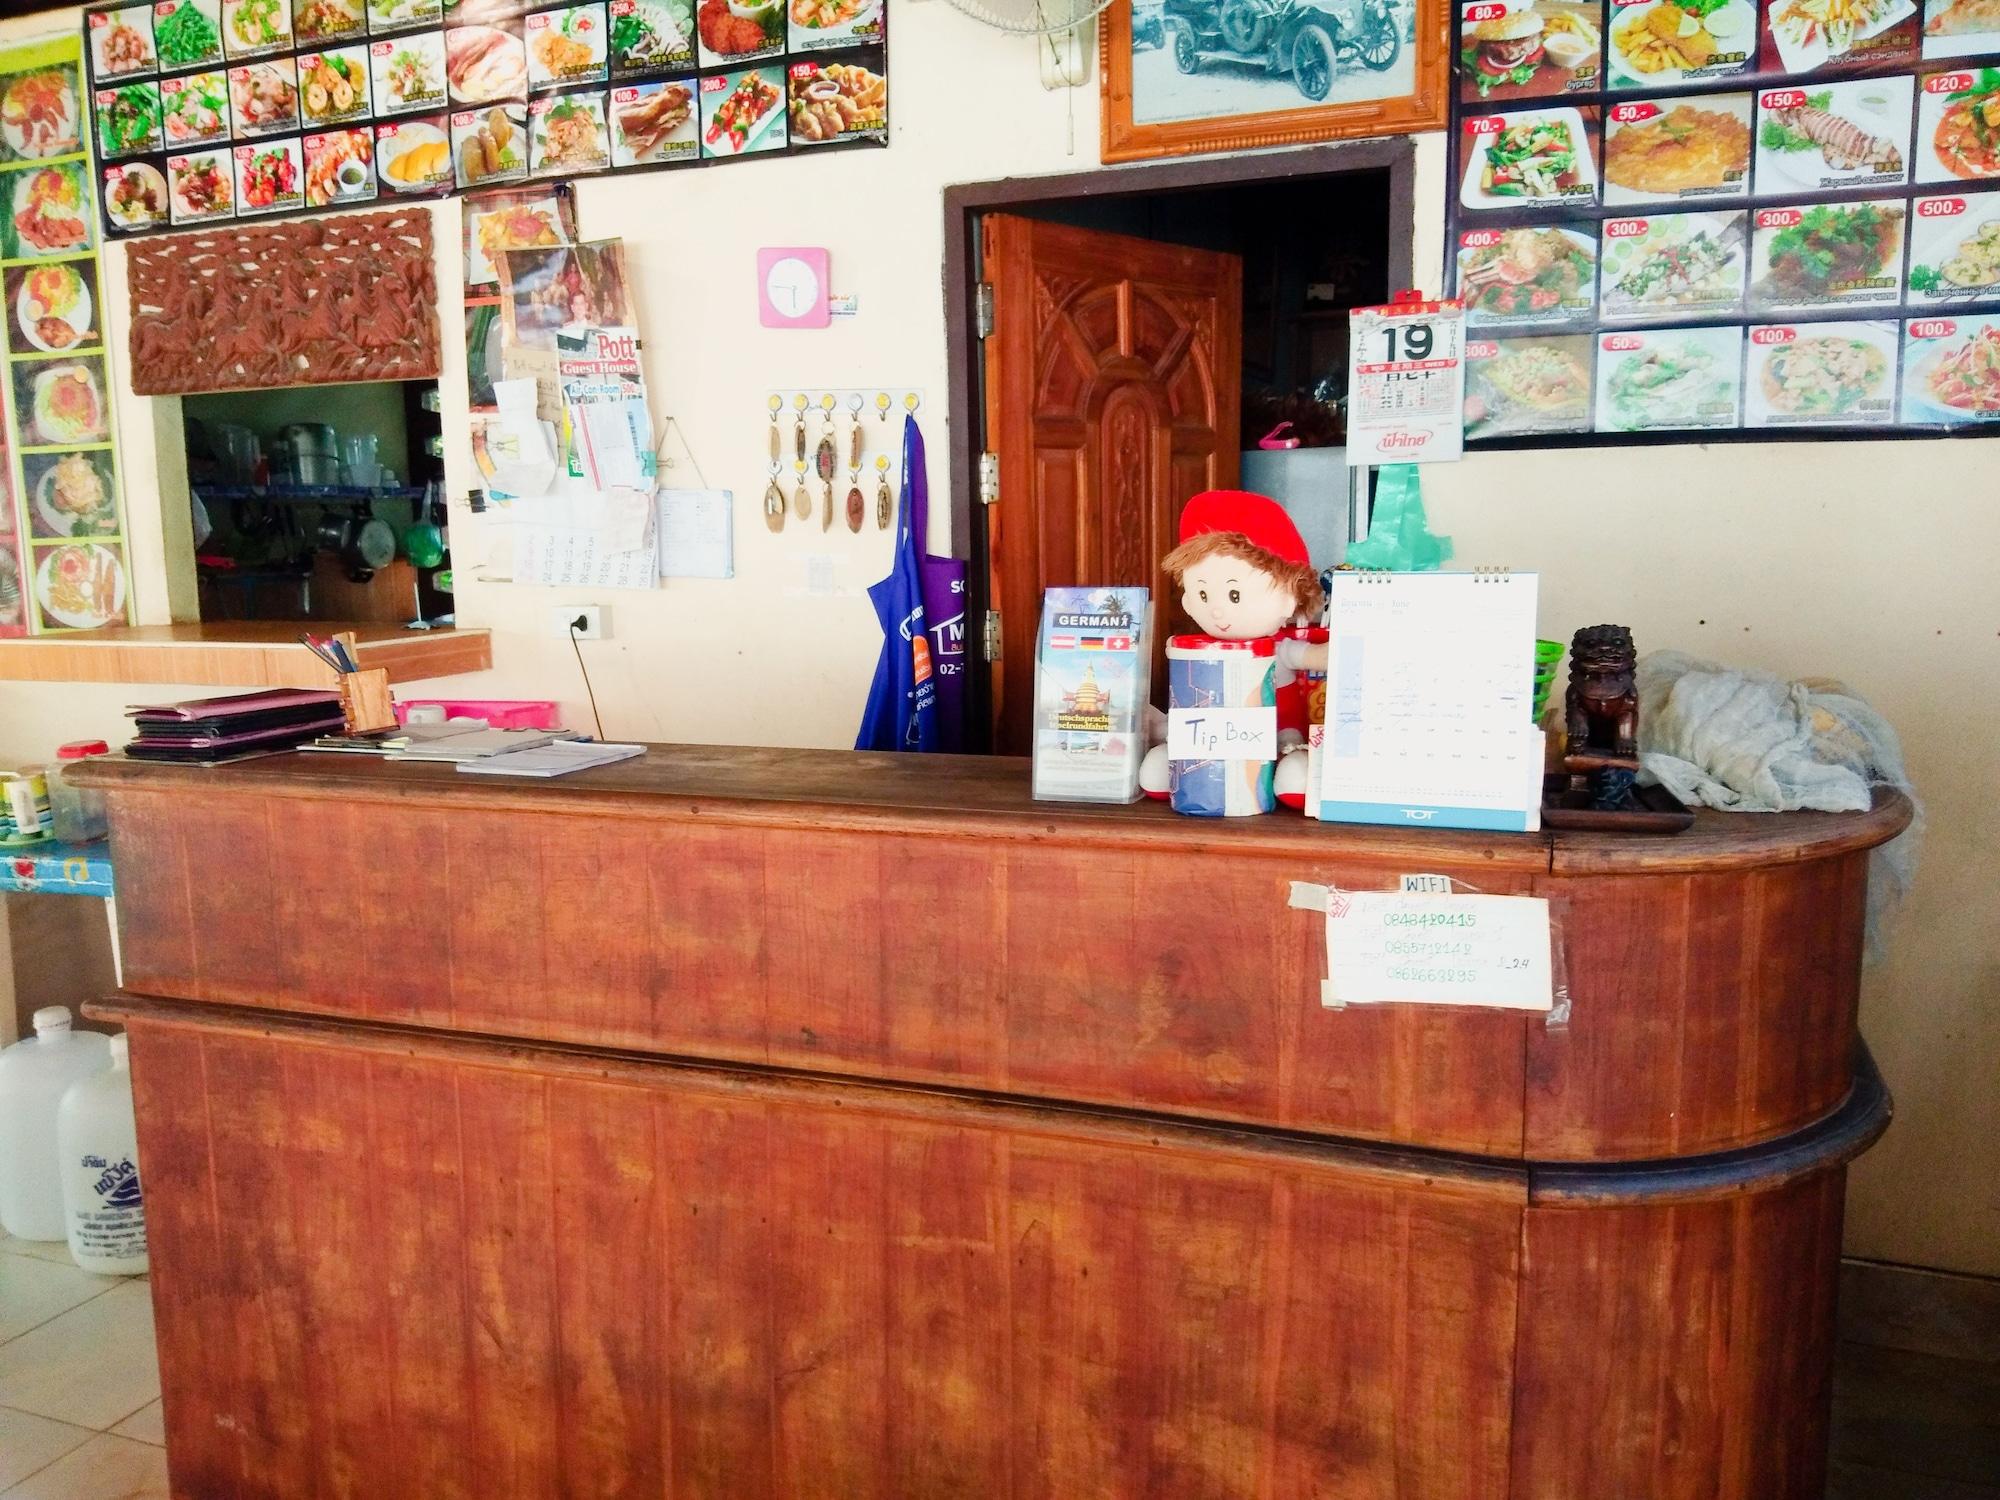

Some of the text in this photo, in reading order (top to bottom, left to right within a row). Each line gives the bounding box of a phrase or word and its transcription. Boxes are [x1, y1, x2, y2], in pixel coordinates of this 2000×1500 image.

[1474, 5, 1502, 19] 80.-
[792, 66, 816, 77] 150.-
[703, 79, 726, 91] 200.-
[1930, 77, 1970, 91] 120.-
[616, 90, 637, 101] 100.-
[1764, 93, 1804, 107] 150.-
[1618, 107, 1647, 120] 50.-
[1472, 120, 1500, 133] 70.-
[1923, 201, 1965, 215] 500.-
[1762, 212, 1801, 225] 300.-
[1610, 223, 1647, 236] 300.-
[1464, 232, 1501, 246] 400.-
[1758, 329, 1796, 343] 100.-
[1916, 322, 1955, 336] 100.-
[597, 334, 635, 359] Pott
[1382, 324, 1433, 362] 19
[1611, 337, 1640, 350] 50.-
[562, 362, 637, 374] Guest House
[1185, 718, 1264, 752] Tip Box
[1400, 808, 1439, 820] TOT
[1406, 876, 1448, 893] WIFI
